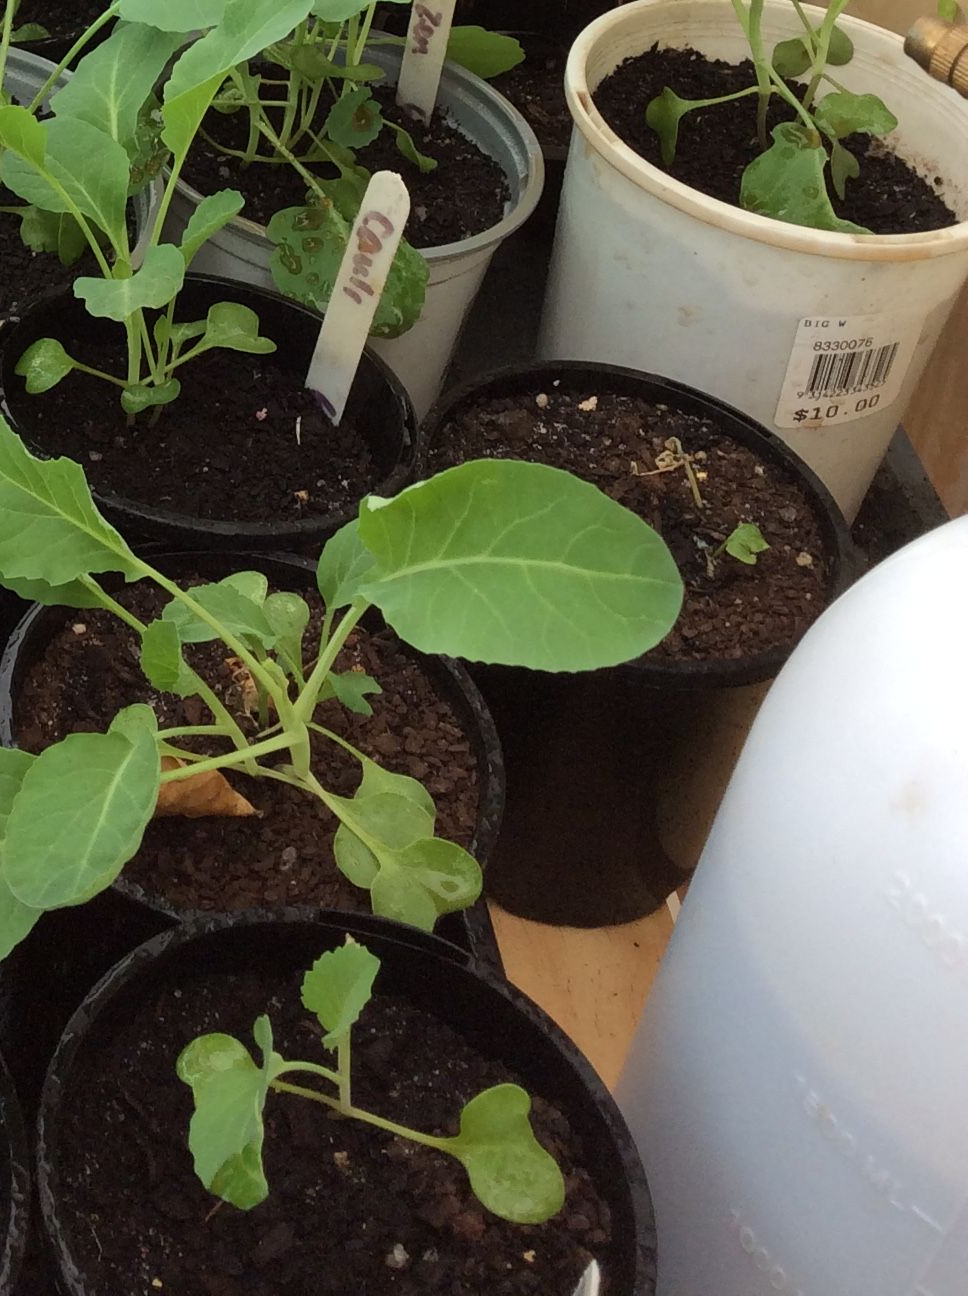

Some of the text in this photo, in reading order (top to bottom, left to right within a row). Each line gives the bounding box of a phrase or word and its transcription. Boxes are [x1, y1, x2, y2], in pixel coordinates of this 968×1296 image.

[803, 319, 847, 328] BIG W
[792, 394, 881, 423] $10.00
